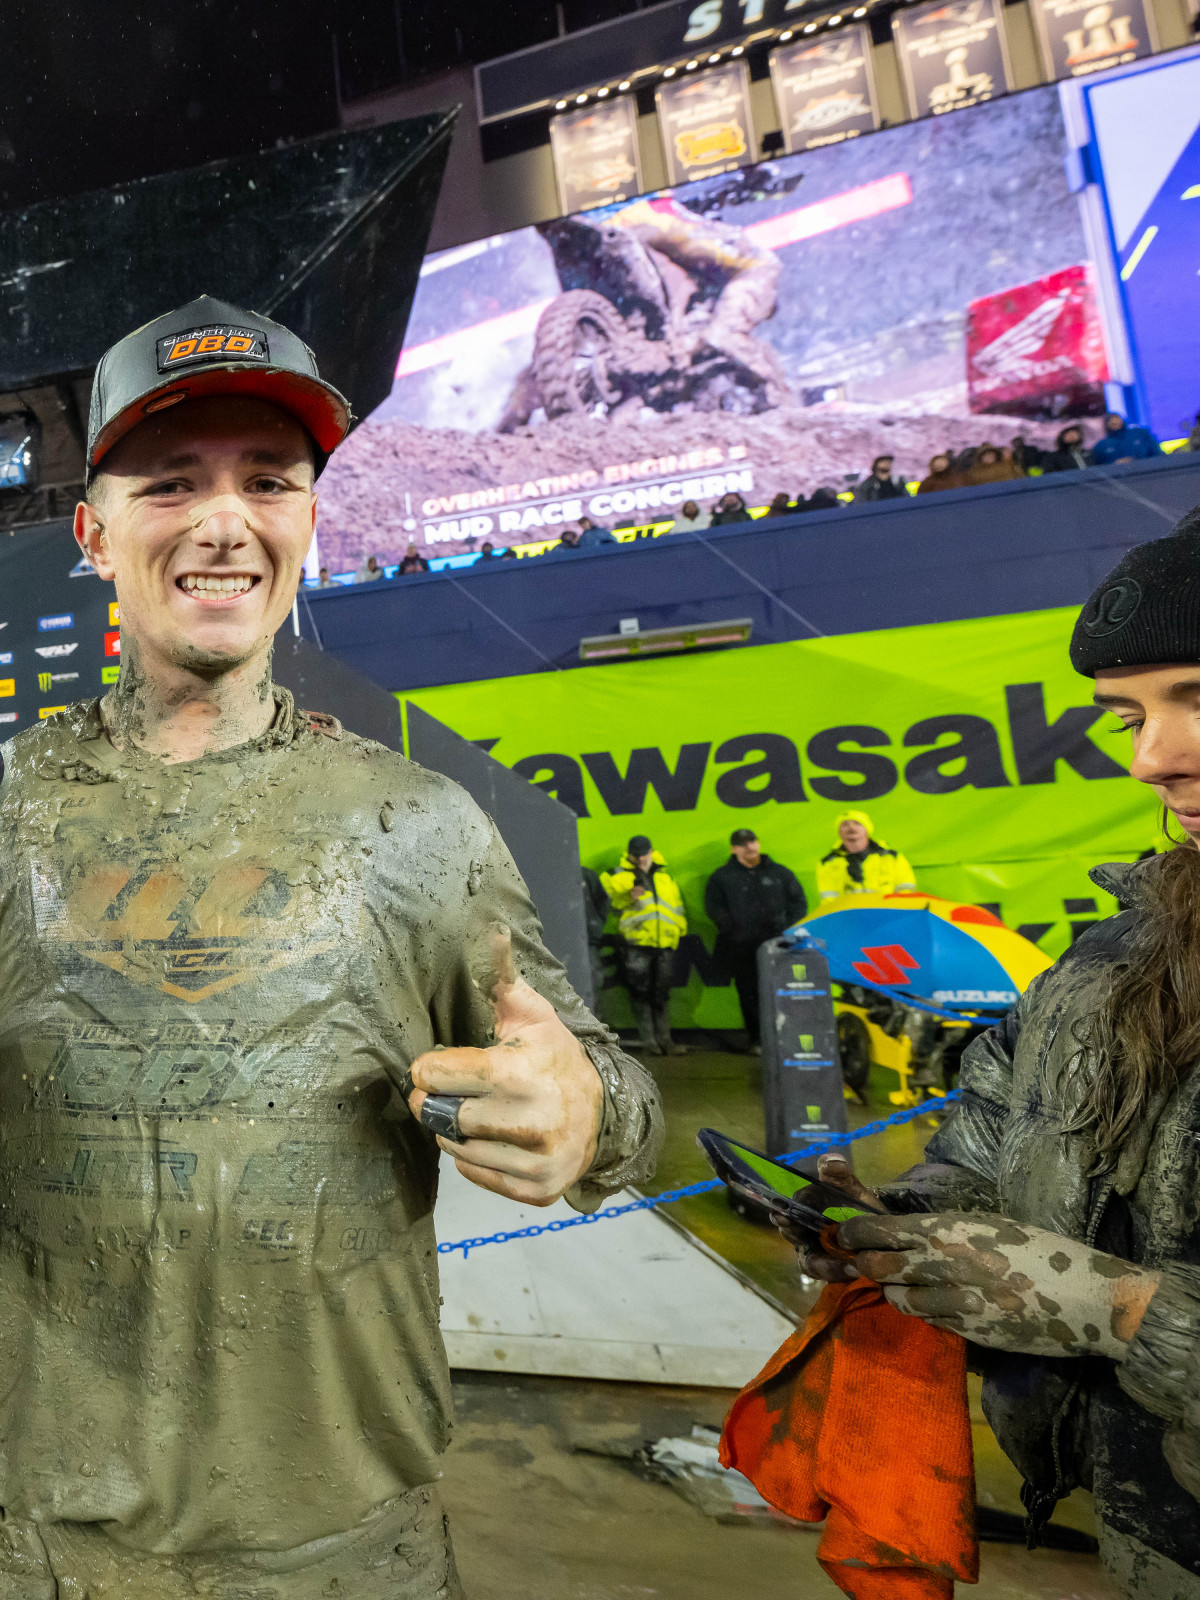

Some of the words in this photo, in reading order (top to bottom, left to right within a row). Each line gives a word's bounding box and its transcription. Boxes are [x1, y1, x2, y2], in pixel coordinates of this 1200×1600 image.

[169, 335, 253, 360] DBD
[422, 470, 599, 517] OVERHEATING
[603, 446, 725, 484] ENGINES
[424, 514, 494, 546] MUD
[499, 499, 583, 532] RACE
[588, 470, 754, 516] CONCERN
[468, 681, 1132, 818] awasak
[931, 989, 1018, 1004] SUZUKI
